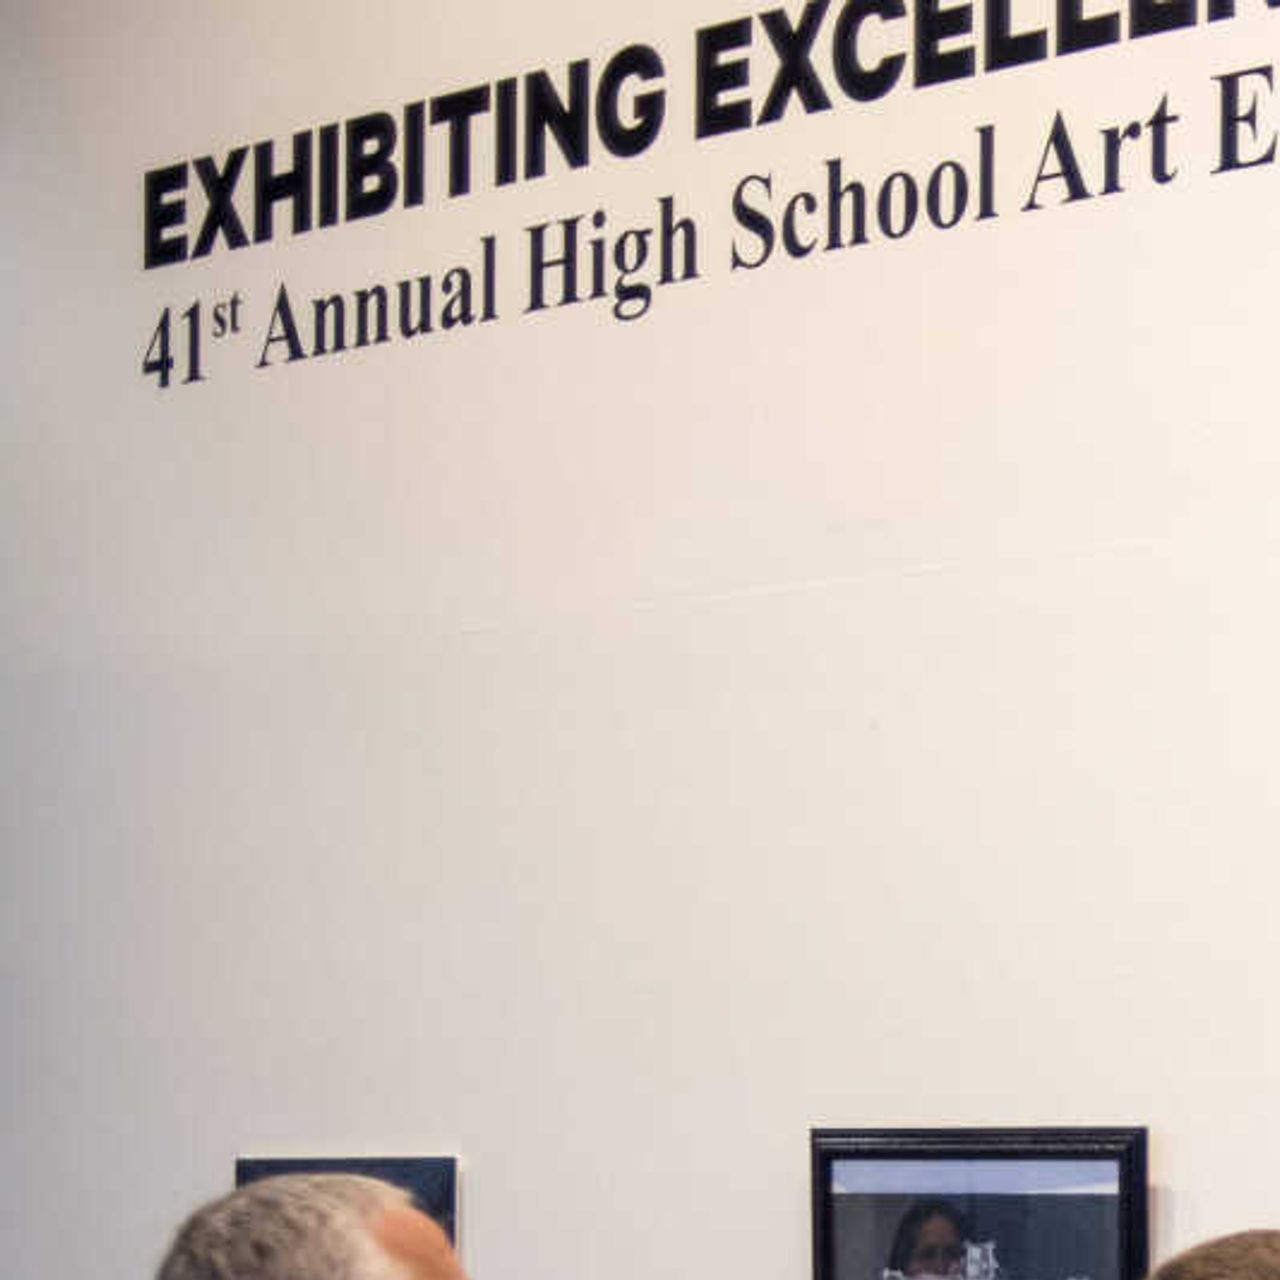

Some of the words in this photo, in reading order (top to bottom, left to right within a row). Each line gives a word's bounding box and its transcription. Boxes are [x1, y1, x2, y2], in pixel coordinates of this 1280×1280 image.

[141, 290, 243, 390] 41st
[255, 236, 498, 367] Annual
[523, 195, 700, 321] High
[730, 123, 1000, 272] School
[1020, 92, 1180, 212] Art
[143, 43, 667, 270] EXHIBITING
